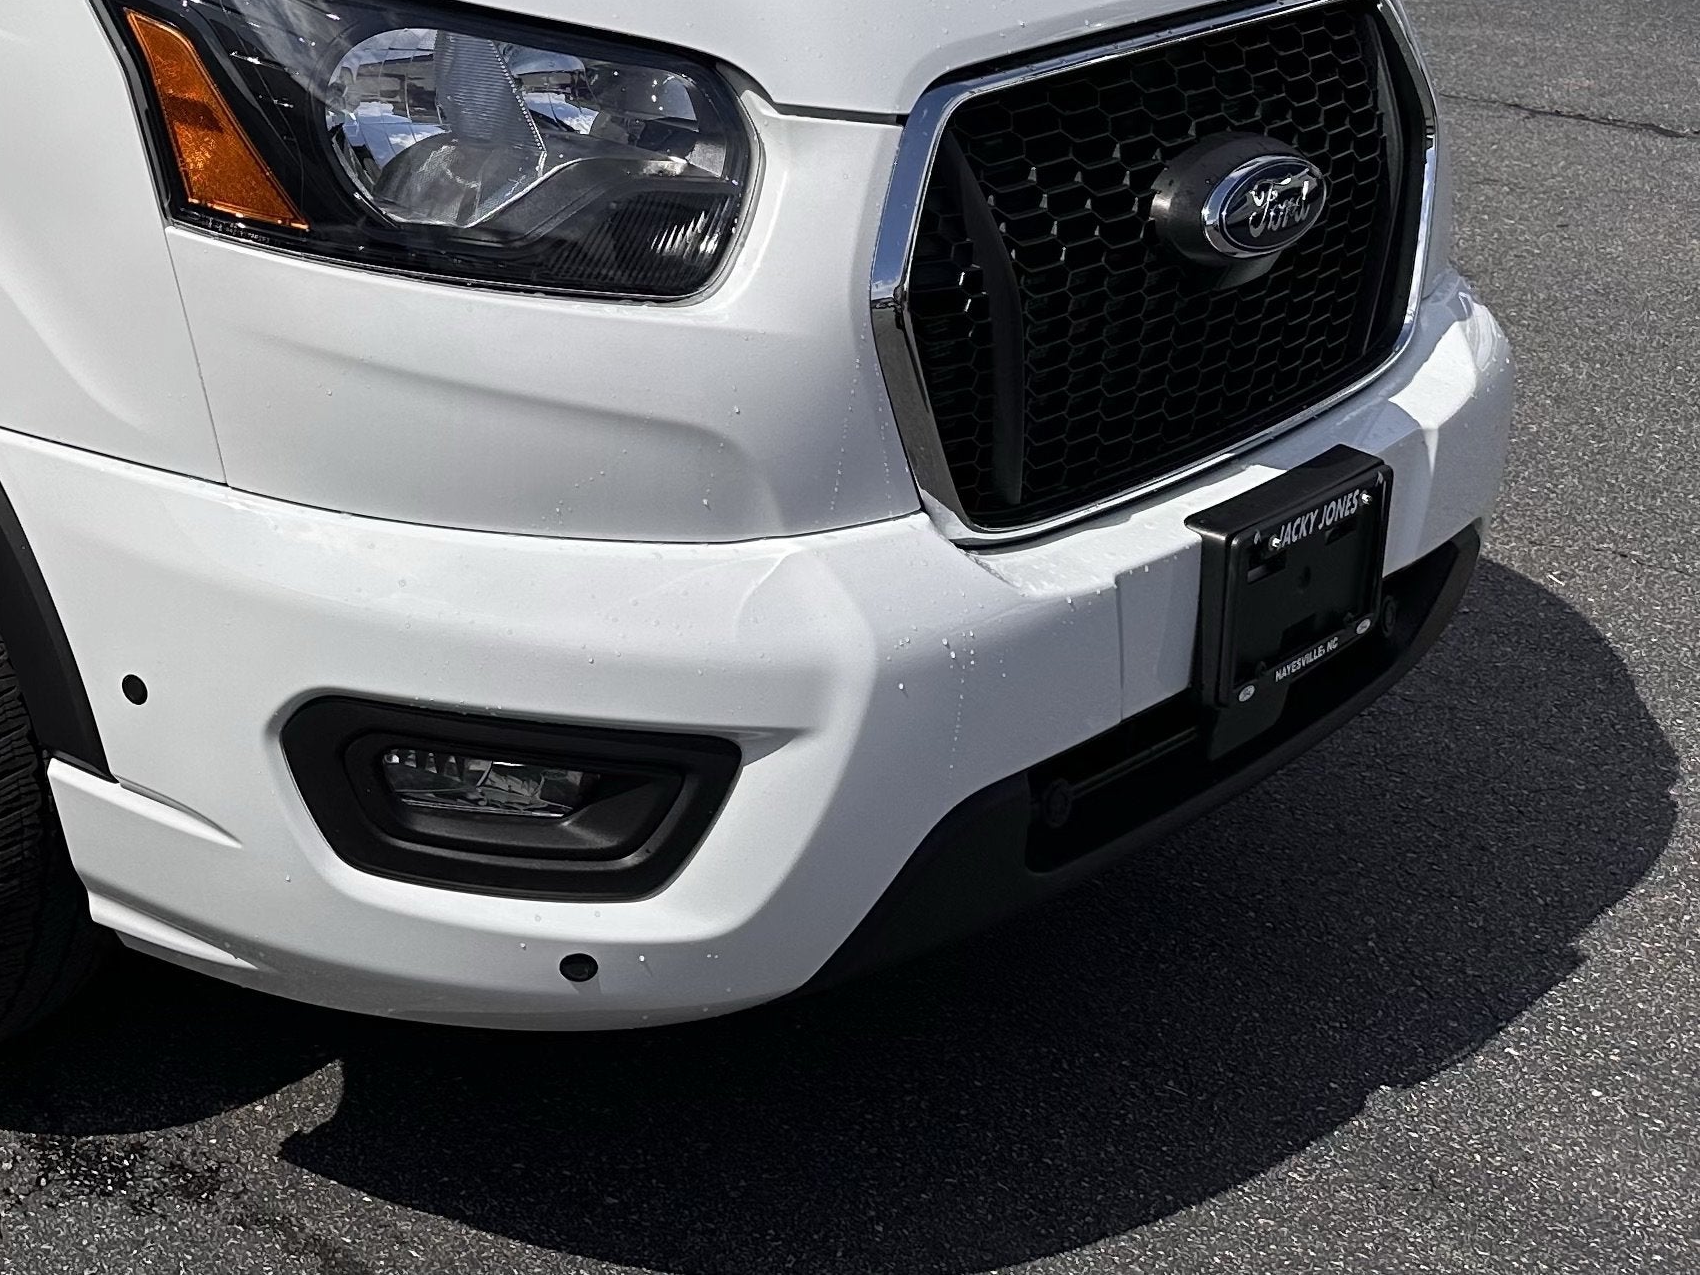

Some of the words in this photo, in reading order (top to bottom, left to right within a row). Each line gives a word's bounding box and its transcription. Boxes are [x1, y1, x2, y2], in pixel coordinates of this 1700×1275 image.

[1248, 174, 1311, 238] Ford
[1279, 508, 1319, 547] JACKY
[1317, 488, 1360, 530] JONES
[1326, 636, 1339, 653] NC
